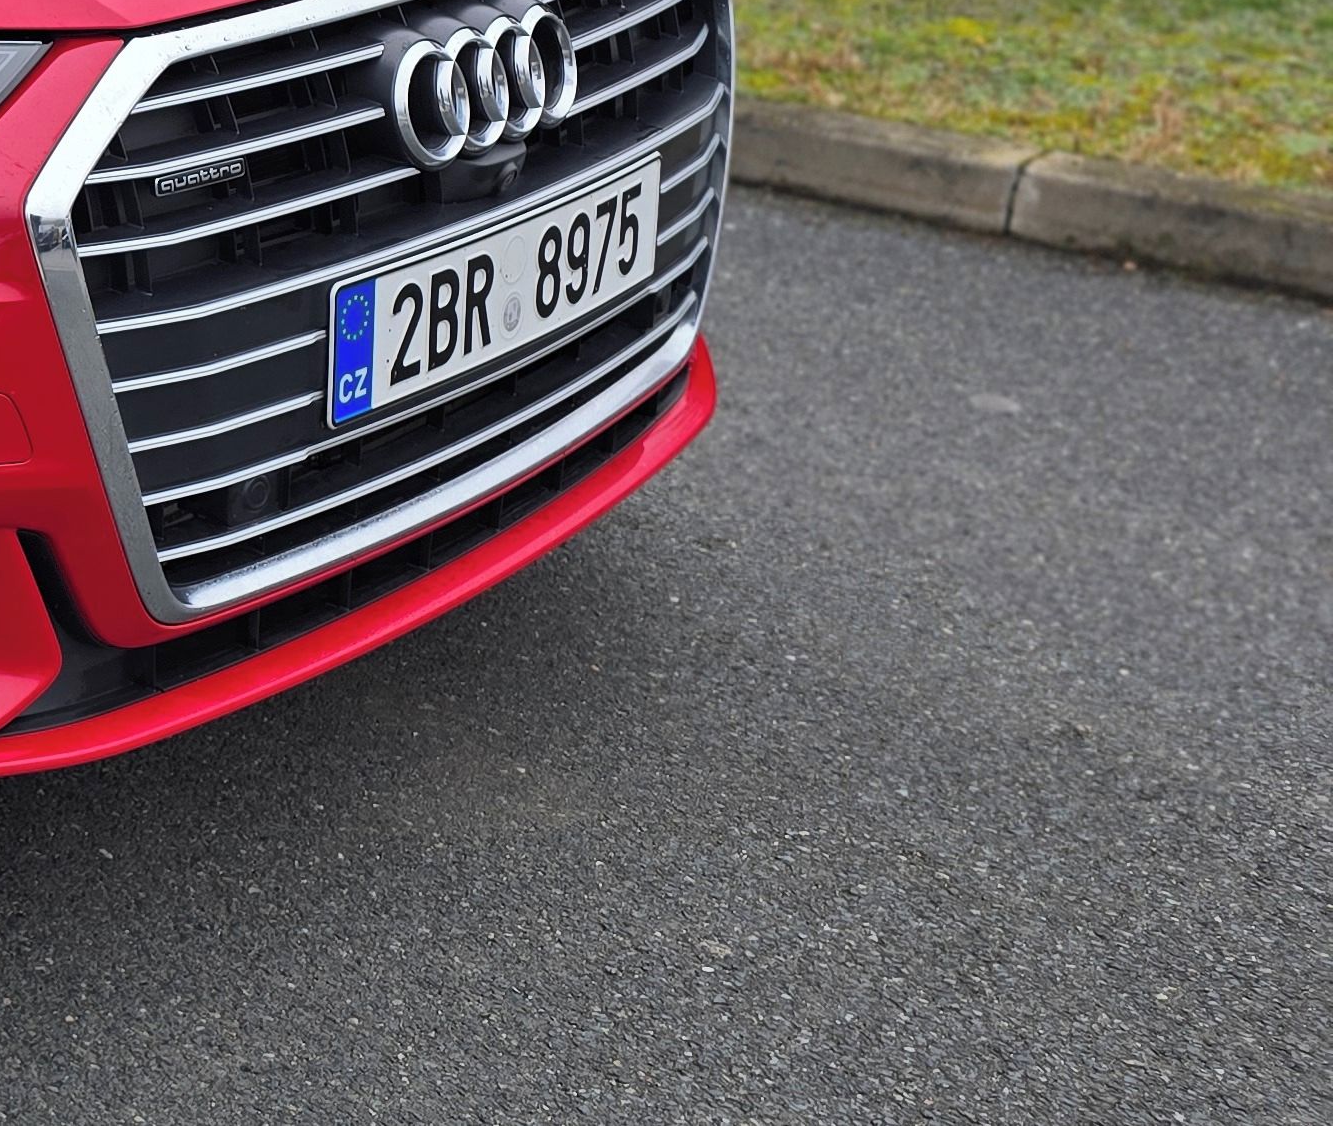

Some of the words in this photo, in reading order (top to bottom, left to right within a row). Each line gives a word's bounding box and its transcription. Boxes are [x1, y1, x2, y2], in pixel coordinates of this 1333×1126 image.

[160, 162, 242, 192] quattro
[389, 253, 495, 387] 2BR
[535, 181, 644, 319] 8975
[338, 366, 368, 404] CZ
